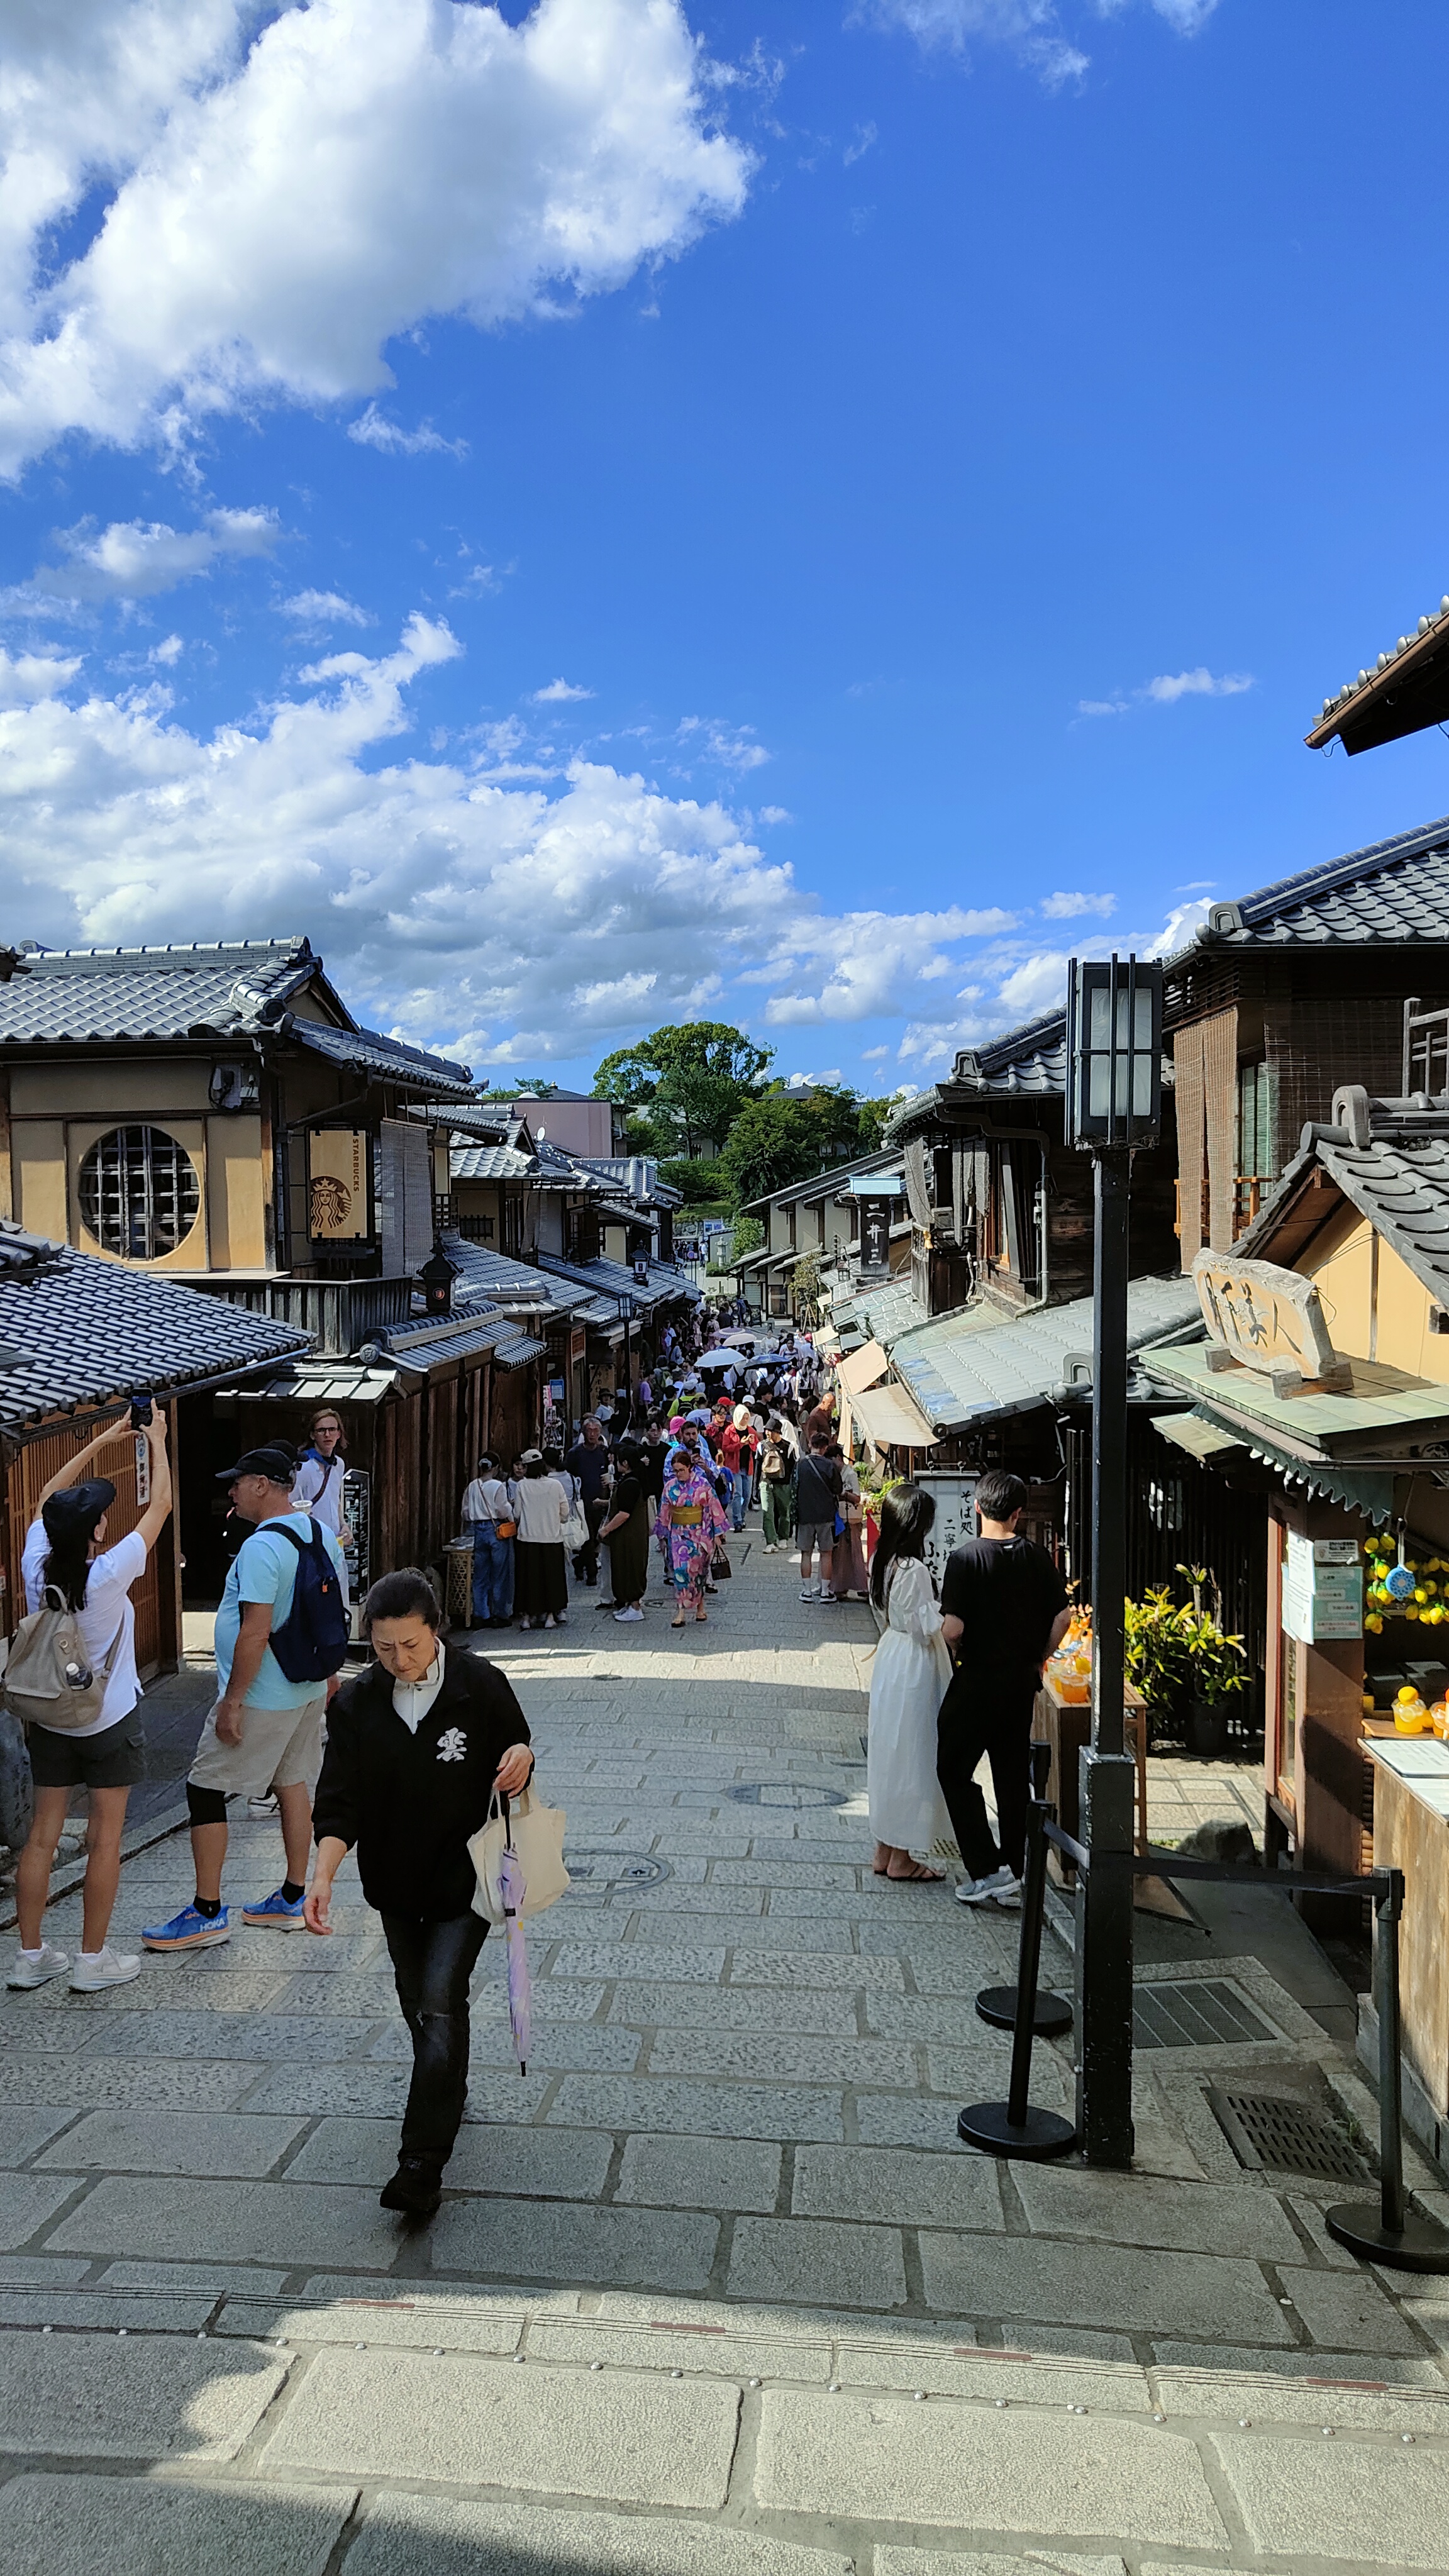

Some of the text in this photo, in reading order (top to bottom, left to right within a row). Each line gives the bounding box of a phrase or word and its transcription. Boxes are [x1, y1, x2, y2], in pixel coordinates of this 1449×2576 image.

[960, 1490, 974, 1535] そば処
[919, 1541, 942, 1581] ふた
[436, 1727, 467, 1762] 雲
[199, 1917, 225, 1932] HOKA
